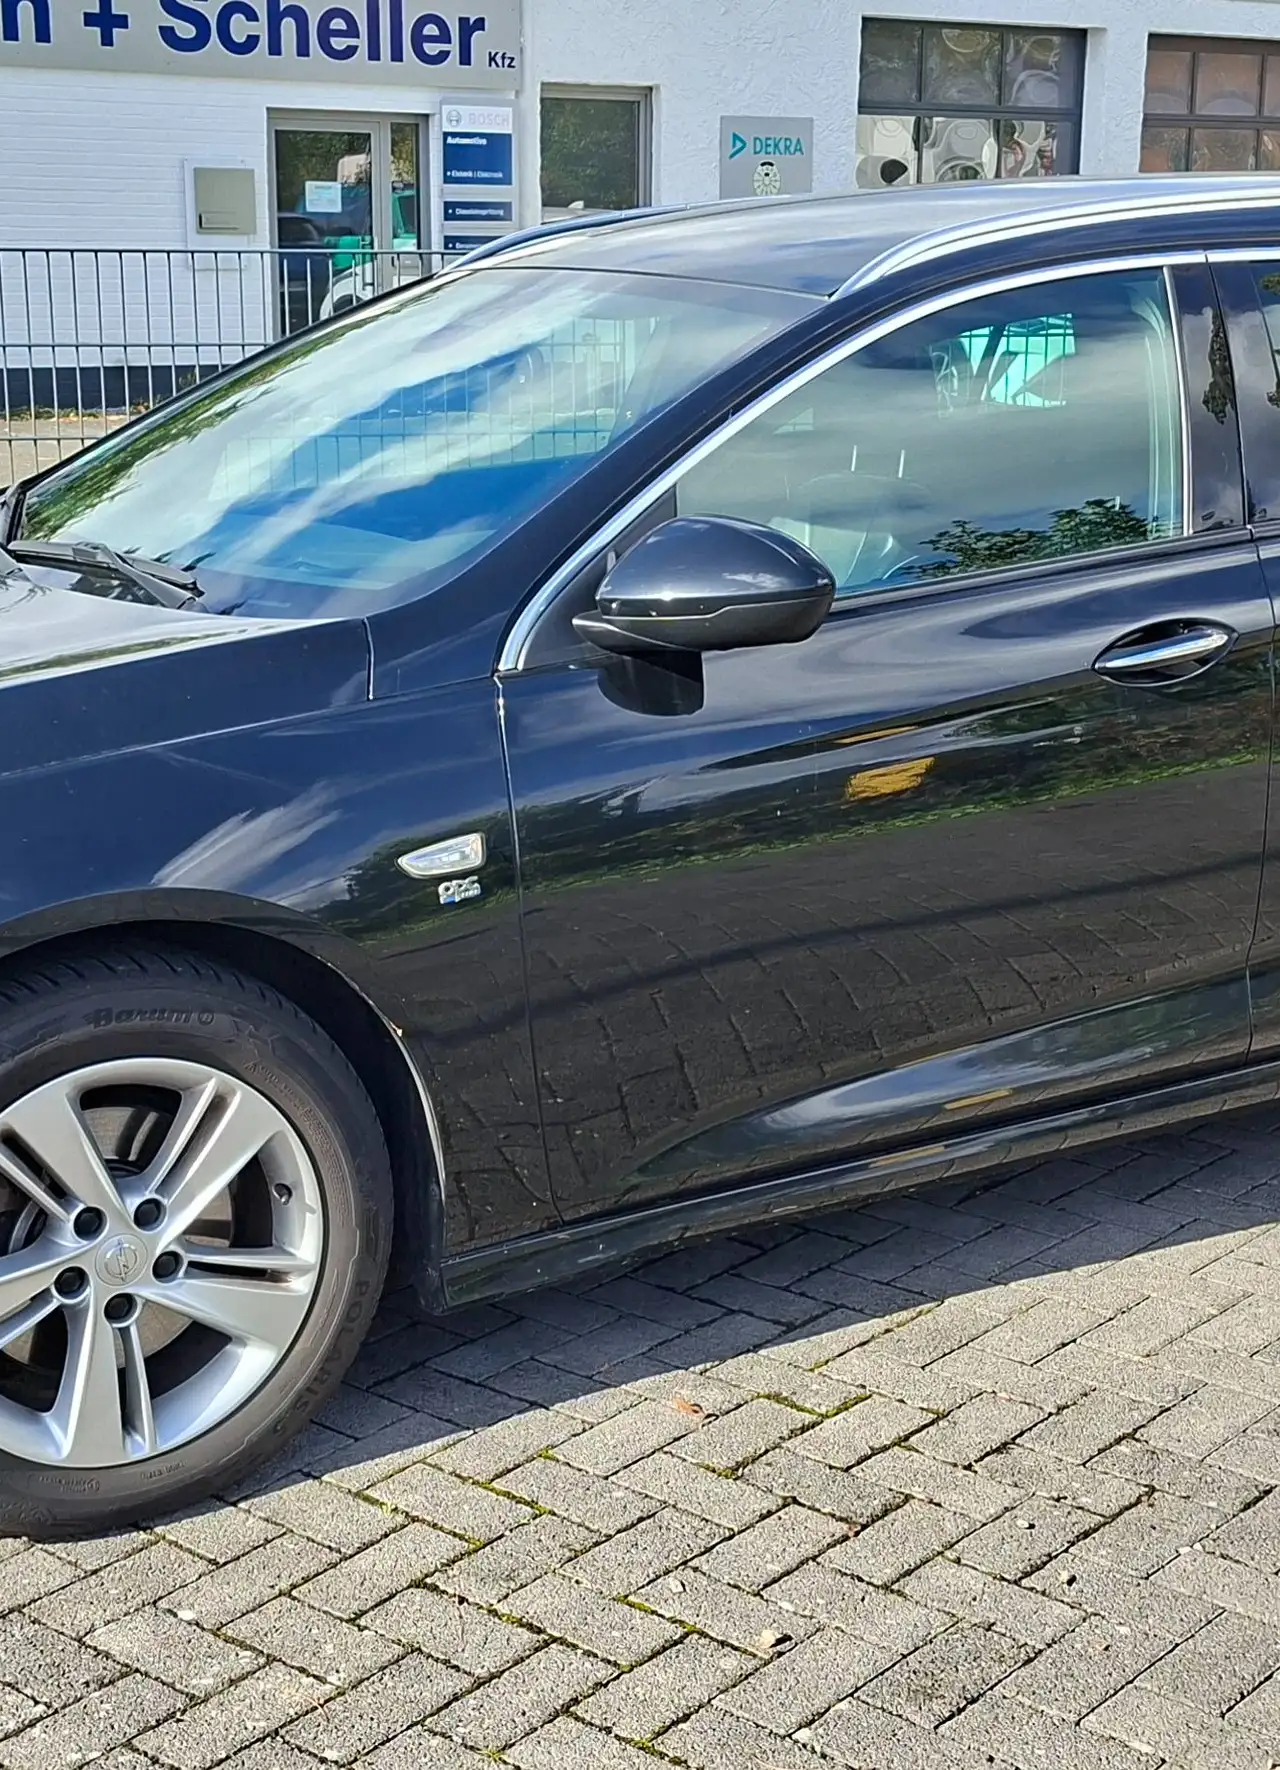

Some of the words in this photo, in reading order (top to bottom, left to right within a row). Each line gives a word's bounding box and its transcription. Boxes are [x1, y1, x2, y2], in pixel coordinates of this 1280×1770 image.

[158, 0, 485, 66] Scheller
[488, 52, 516, 68] Kfz
[468, 112, 510, 127] BOSCH
[753, 137, 804, 155] DEKRA
